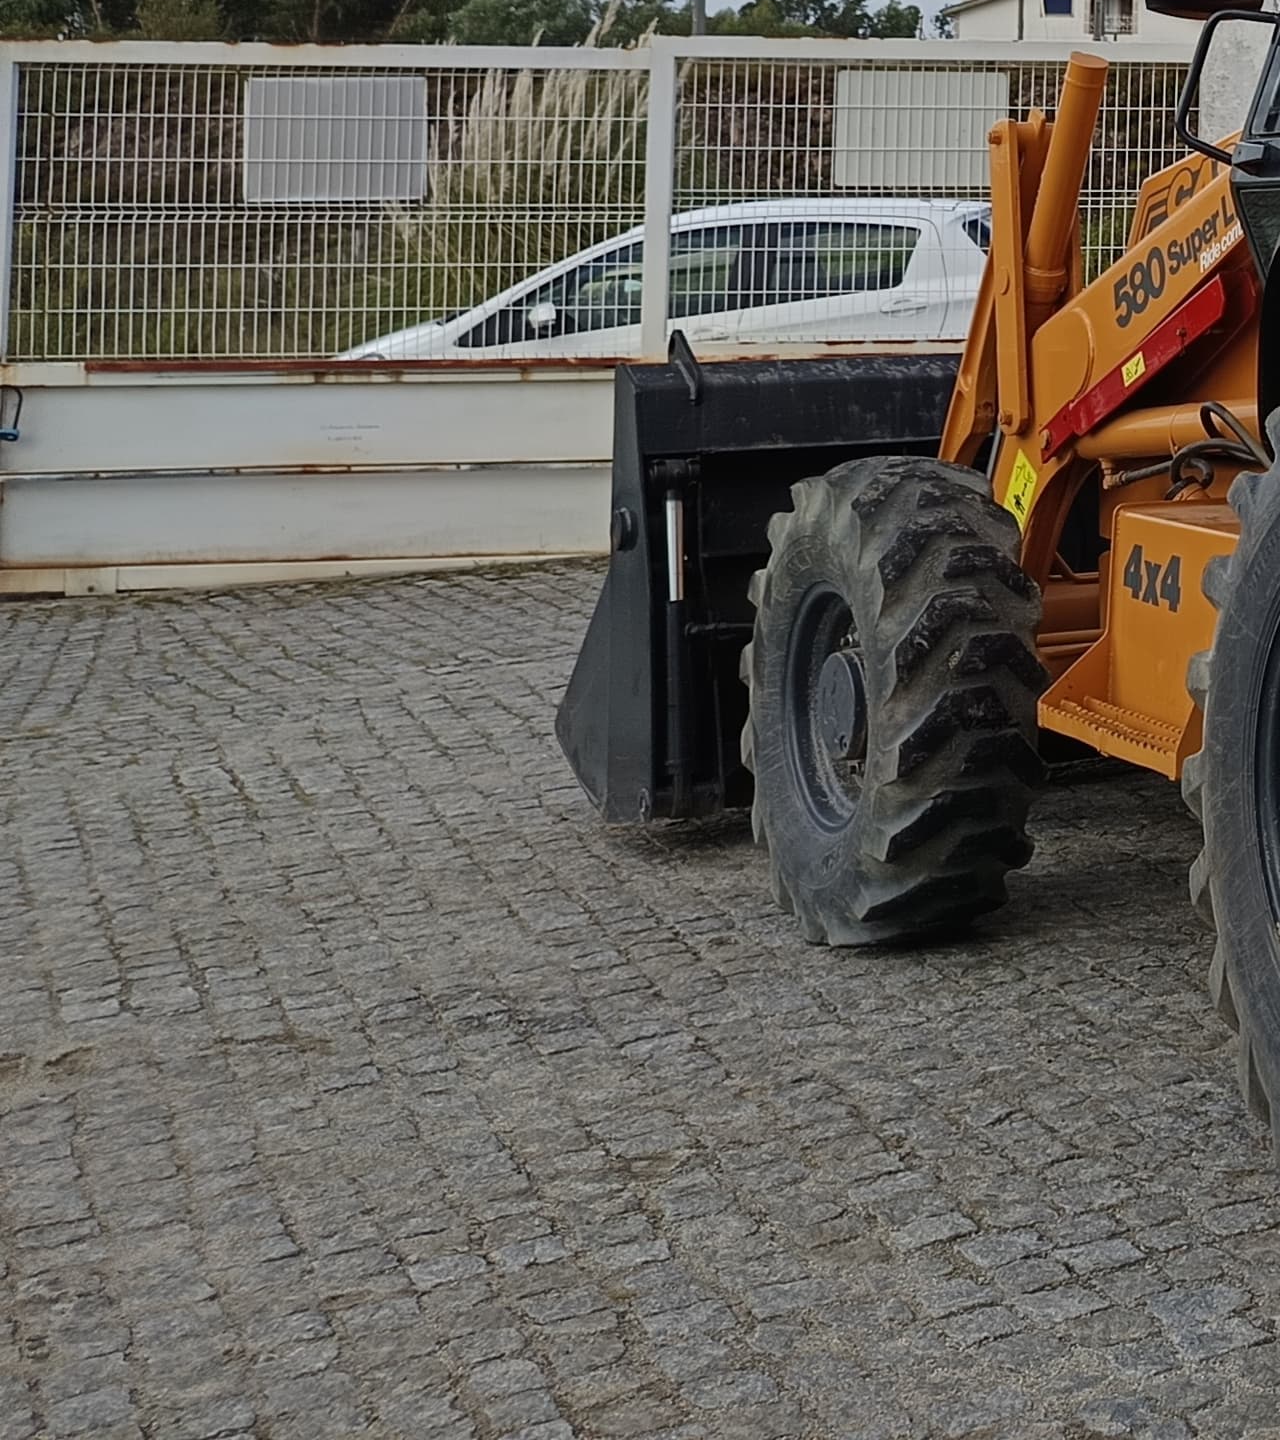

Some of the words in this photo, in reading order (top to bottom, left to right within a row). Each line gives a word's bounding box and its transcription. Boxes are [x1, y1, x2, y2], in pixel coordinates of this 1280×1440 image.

[1114, 246, 1166, 328] 580
[1167, 211, 1220, 276] Super
[1220, 194, 1235, 226] L
[1200, 242, 1221, 274] Ride
[1220, 217, 1244, 252] cont
[1123, 543, 1181, 614] 4x4
